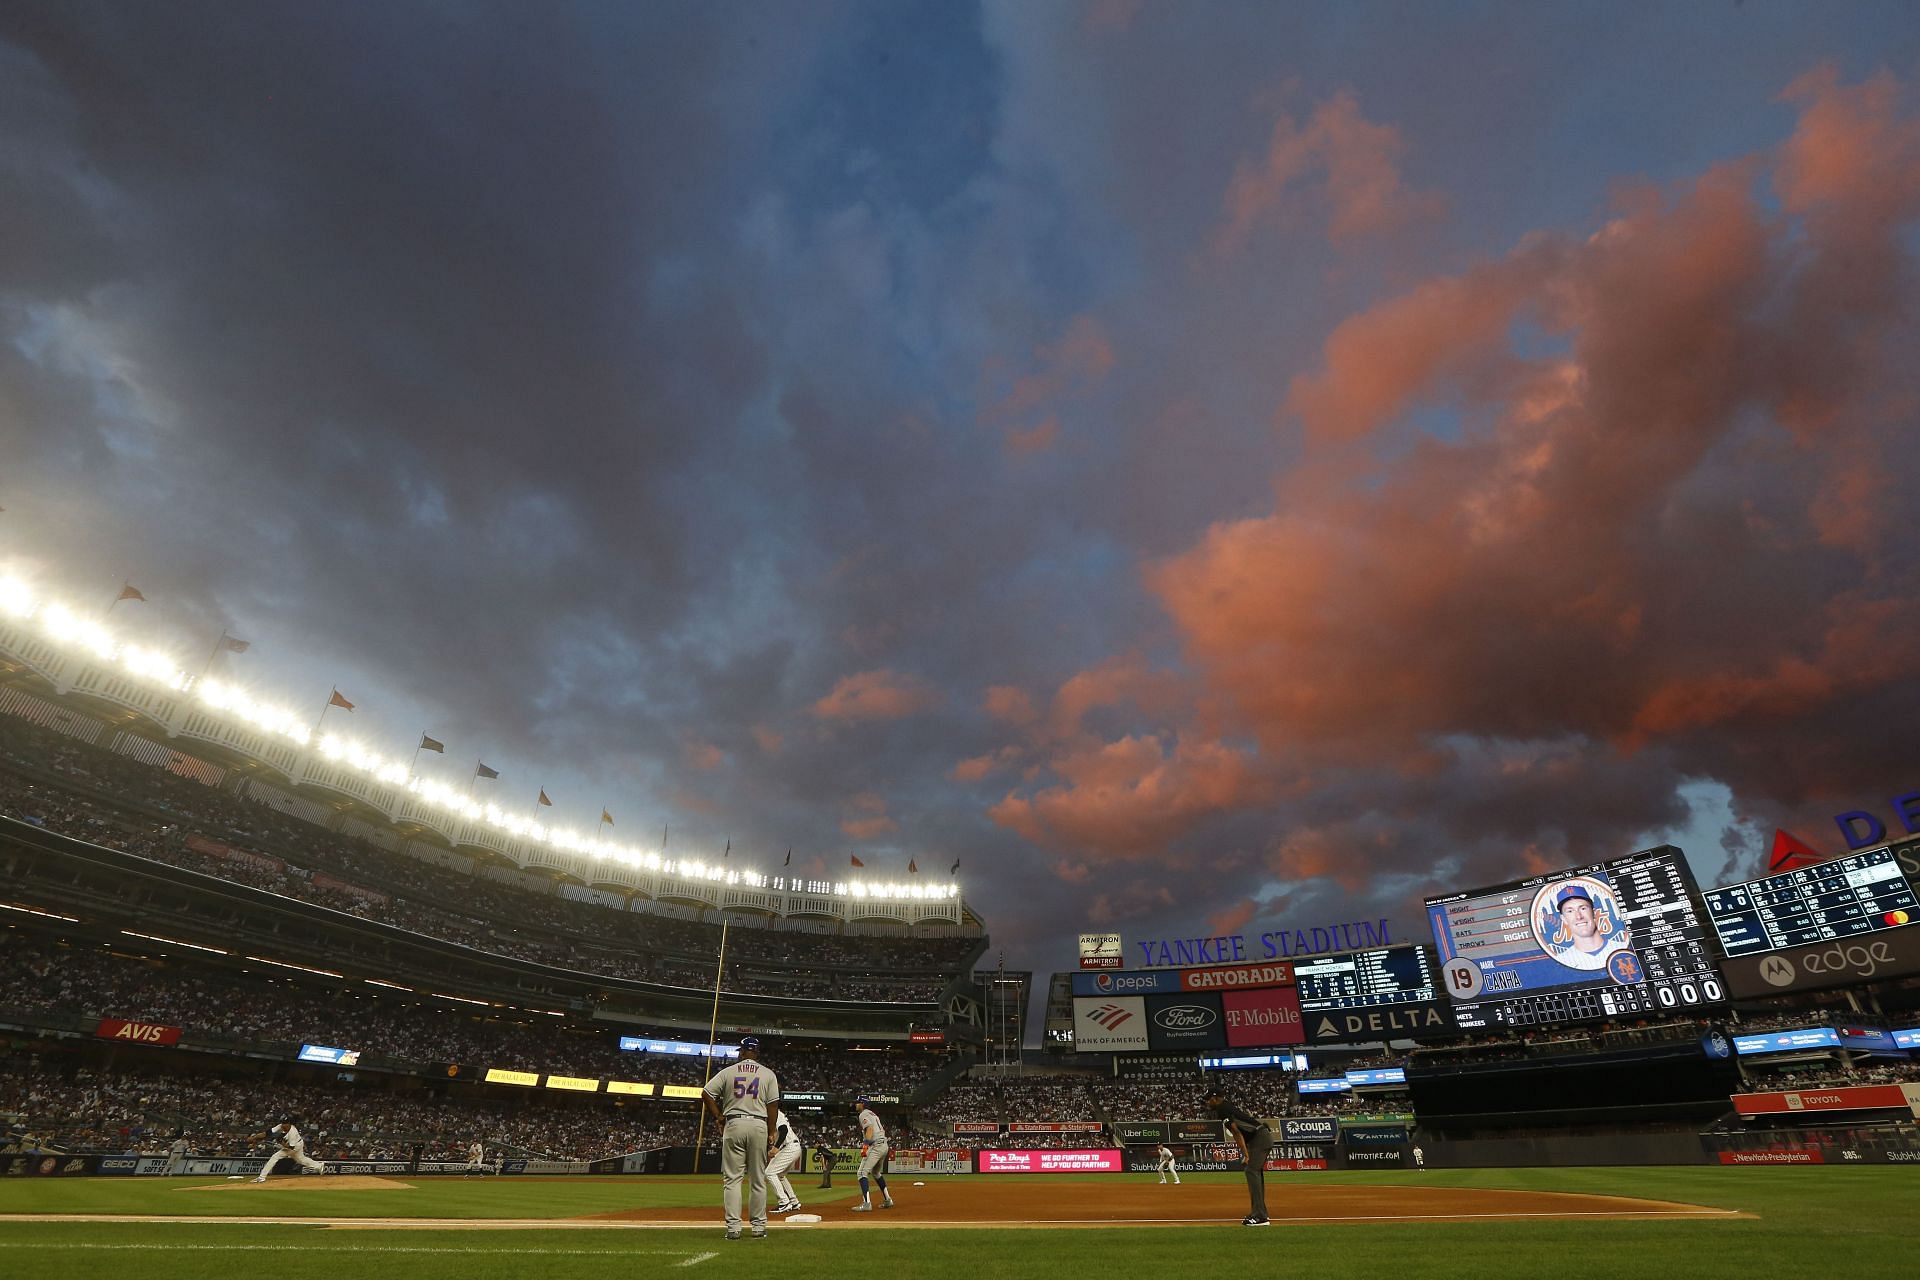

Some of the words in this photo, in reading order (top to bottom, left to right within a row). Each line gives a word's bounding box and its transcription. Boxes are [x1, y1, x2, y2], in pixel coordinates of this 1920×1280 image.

[1635, 893, 1665, 903] VOGELBACH
[1713, 902, 1722, 910] 0
[1737, 896, 1746, 905] 0
[1453, 917, 1475, 925] WEIGHT
[1506, 907, 1522, 916] 209
[1500, 919, 1526, 930] RIGHT
[1138, 935, 1248, 967] YANKEE
[1262, 919, 1392, 959] STADIUM
[1459, 940, 1485, 949] THROWS
[1504, 931, 1529, 942] RIGHT
[1480, 960, 1495, 969] MARK
[1803, 942, 1895, 976] edge
[1116, 975, 1156, 990] pepsi
[1188, 967, 1286, 987] GATORADE
[1451, 968, 1473, 989] 19
[1484, 970, 1522, 991] CANHA
[1659, 987, 1675, 1006] 0
[1681, 984, 1698, 1003] 0
[1704, 980, 1721, 1000] 0
[1166, 1008, 1204, 1026] Ford
[1347, 1008, 1444, 1033] DELTA
[1459, 1020, 1485, 1028] YANKEES
[116, 1023, 164, 1041] AVIS
[738, 1064, 759, 1073] KIRBY
[734, 1077, 759, 1099] 54
[1804, 1096, 1842, 1105] TOYOTA
[1300, 1121, 1331, 1133] coupa
[1008, 1154, 1030, 1163] Boys
[1349, 1152, 1399, 1161] NITTOTIRE.COM
[1842, 1151, 1856, 1160] 385
